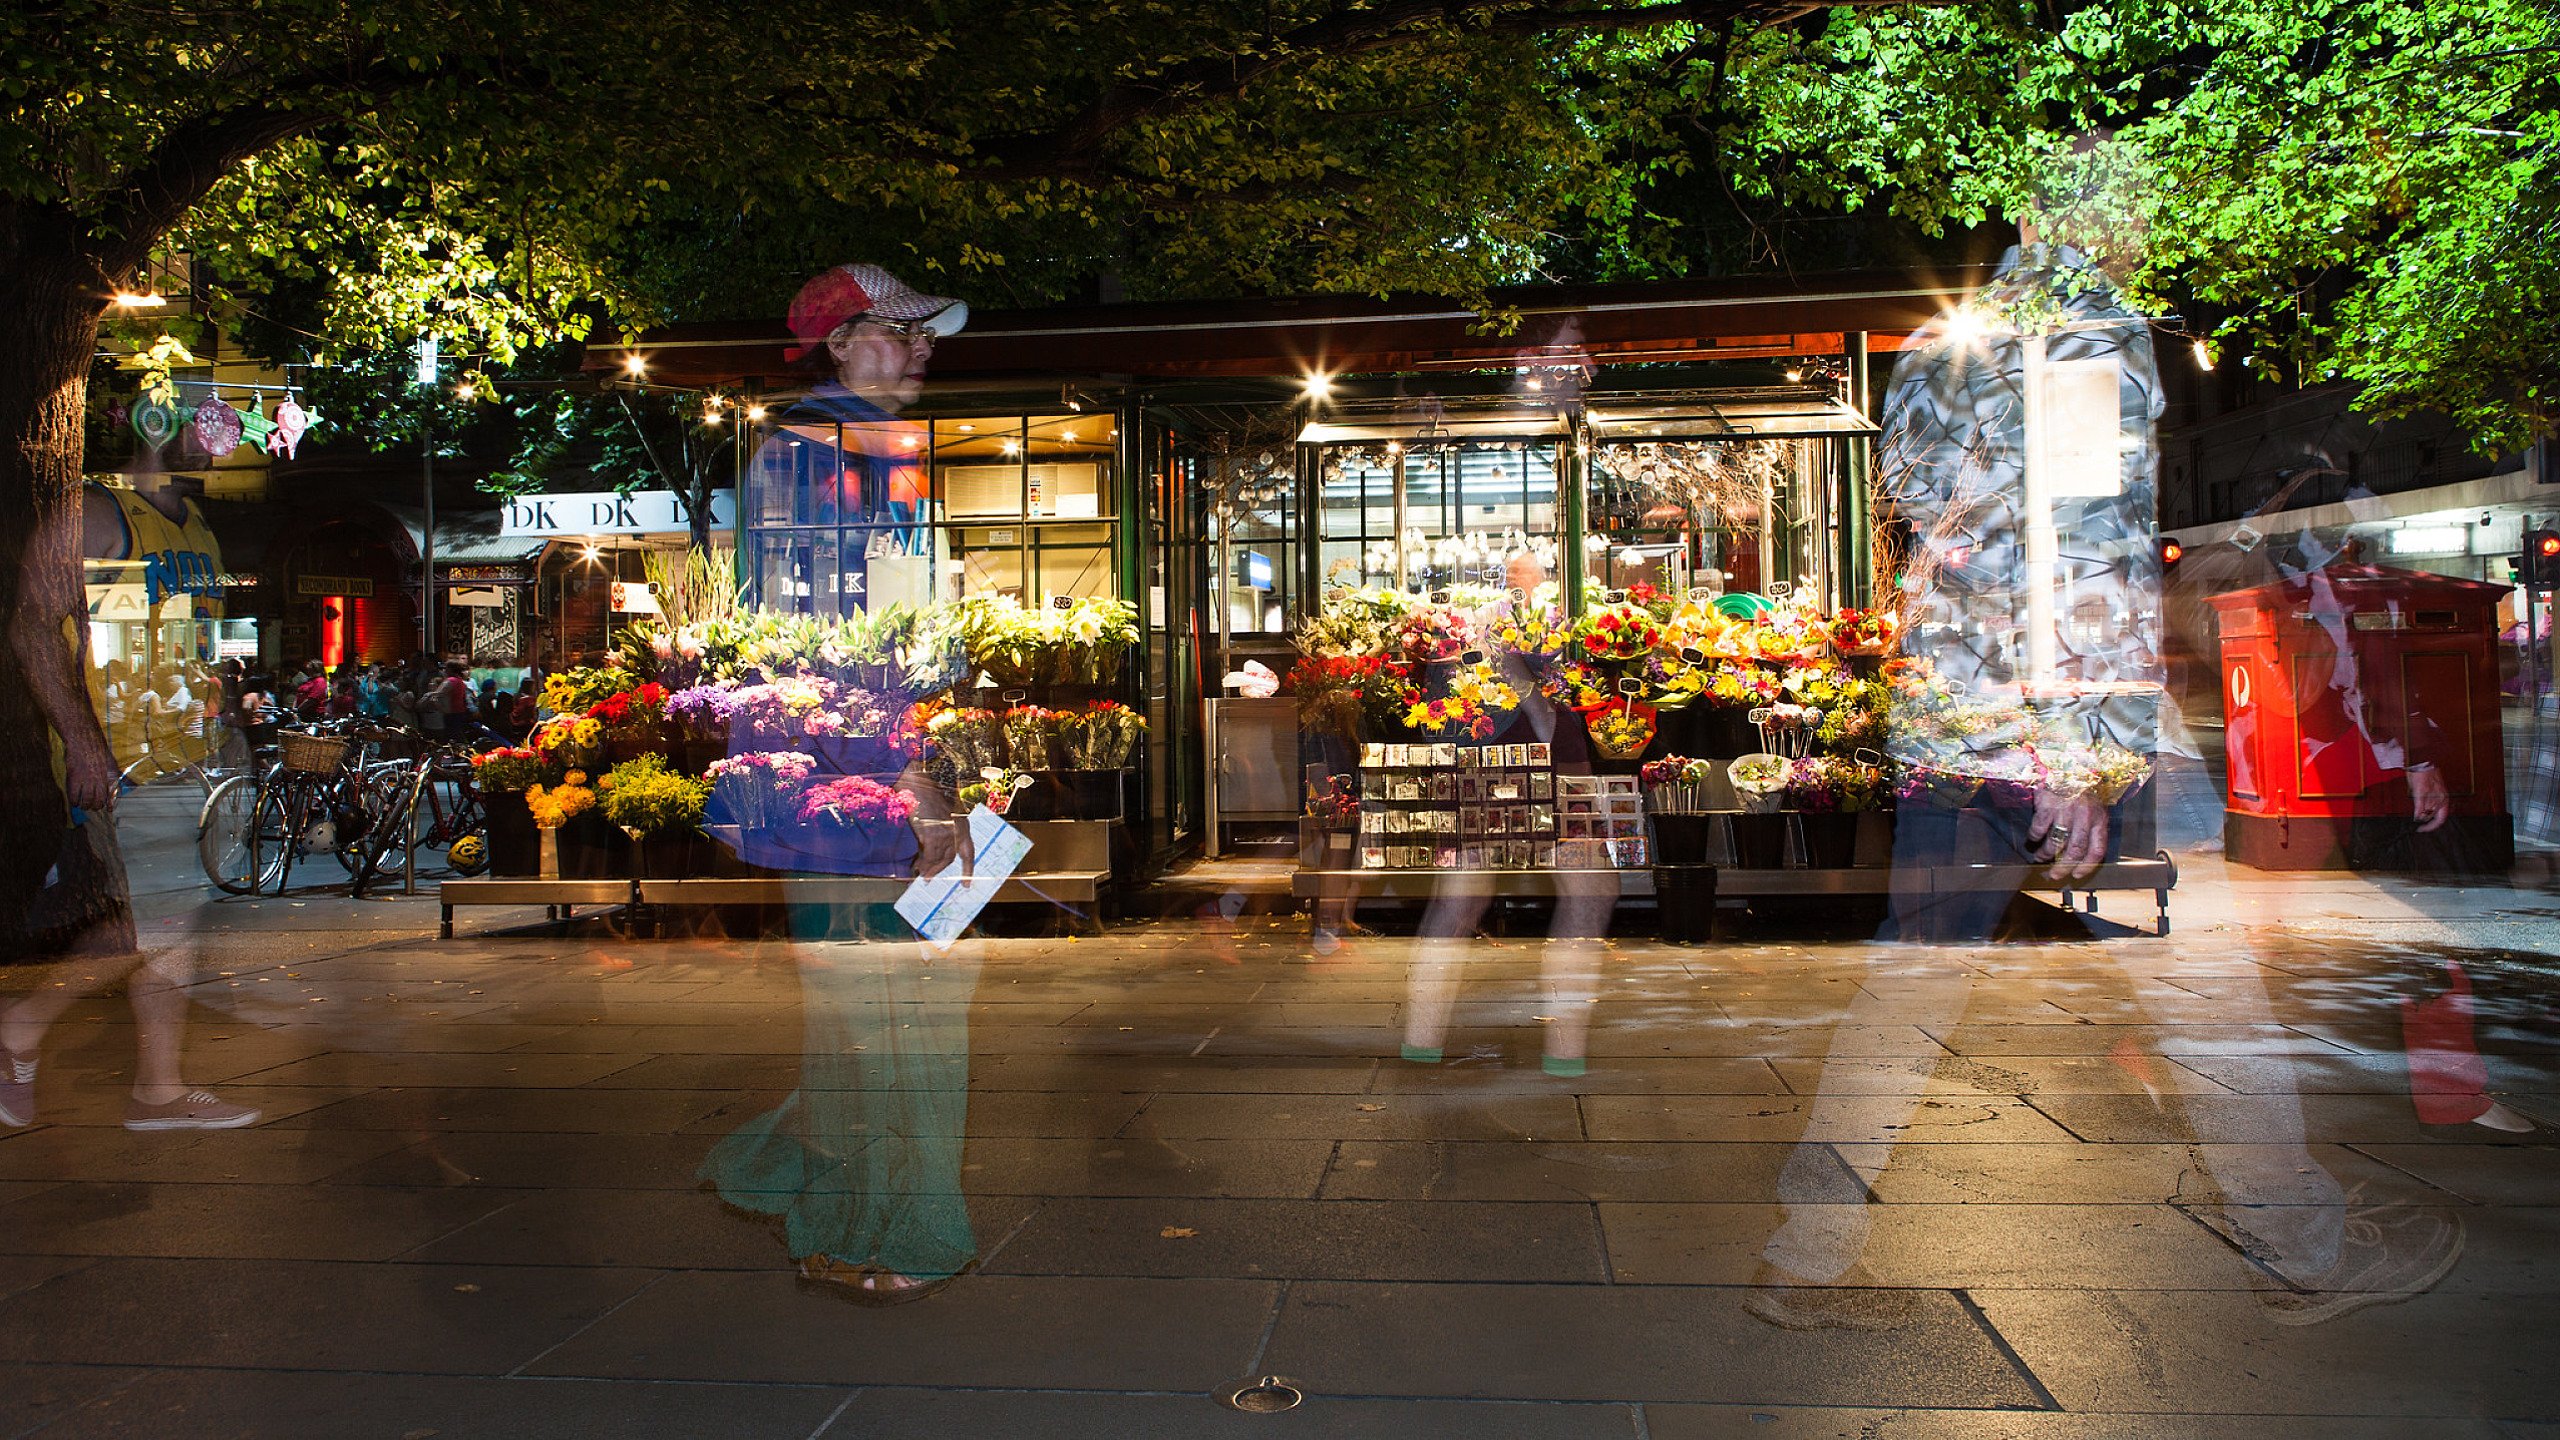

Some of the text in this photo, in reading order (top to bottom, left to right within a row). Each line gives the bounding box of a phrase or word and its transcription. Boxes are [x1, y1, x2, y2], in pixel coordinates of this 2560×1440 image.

[512, 500, 559, 529] DK
[592, 498, 640, 527] DK
[301, 578, 370, 595] SECONDHAND BOOKS
